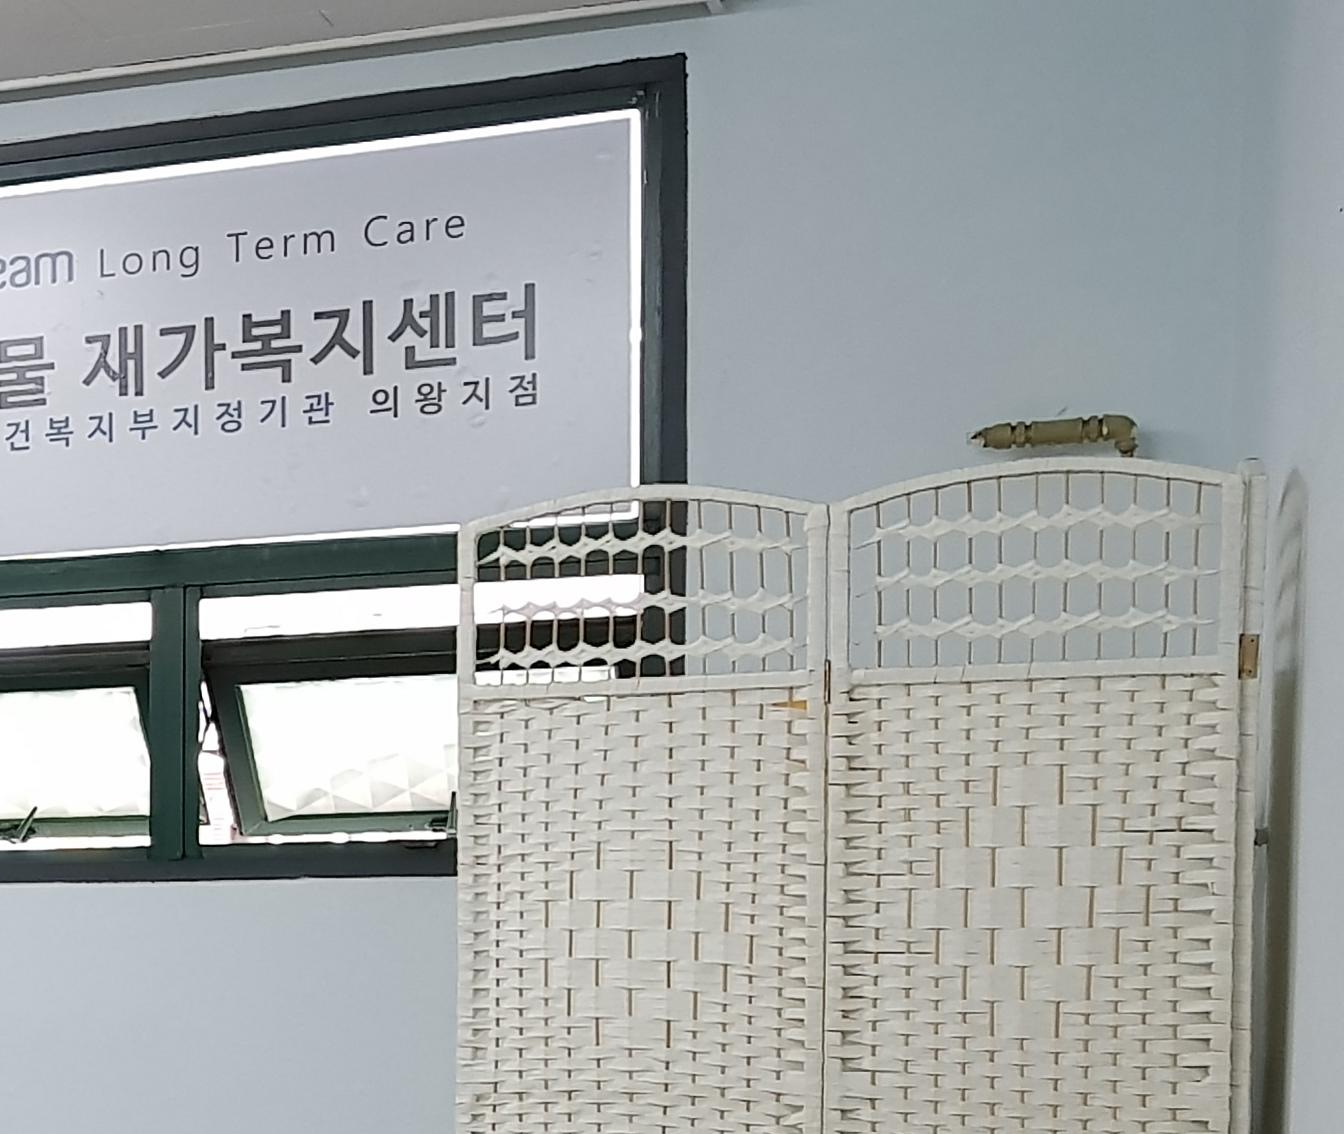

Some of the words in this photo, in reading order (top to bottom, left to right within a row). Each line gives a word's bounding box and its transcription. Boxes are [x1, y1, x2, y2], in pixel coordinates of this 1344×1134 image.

[98, 243, 201, 278] Long
[226, 227, 337, 264] Term
[362, 213, 467, 249] Care
[81, 282, 537, 397] 재가복지센터
[368, 372, 538, 419] 의왕지점
